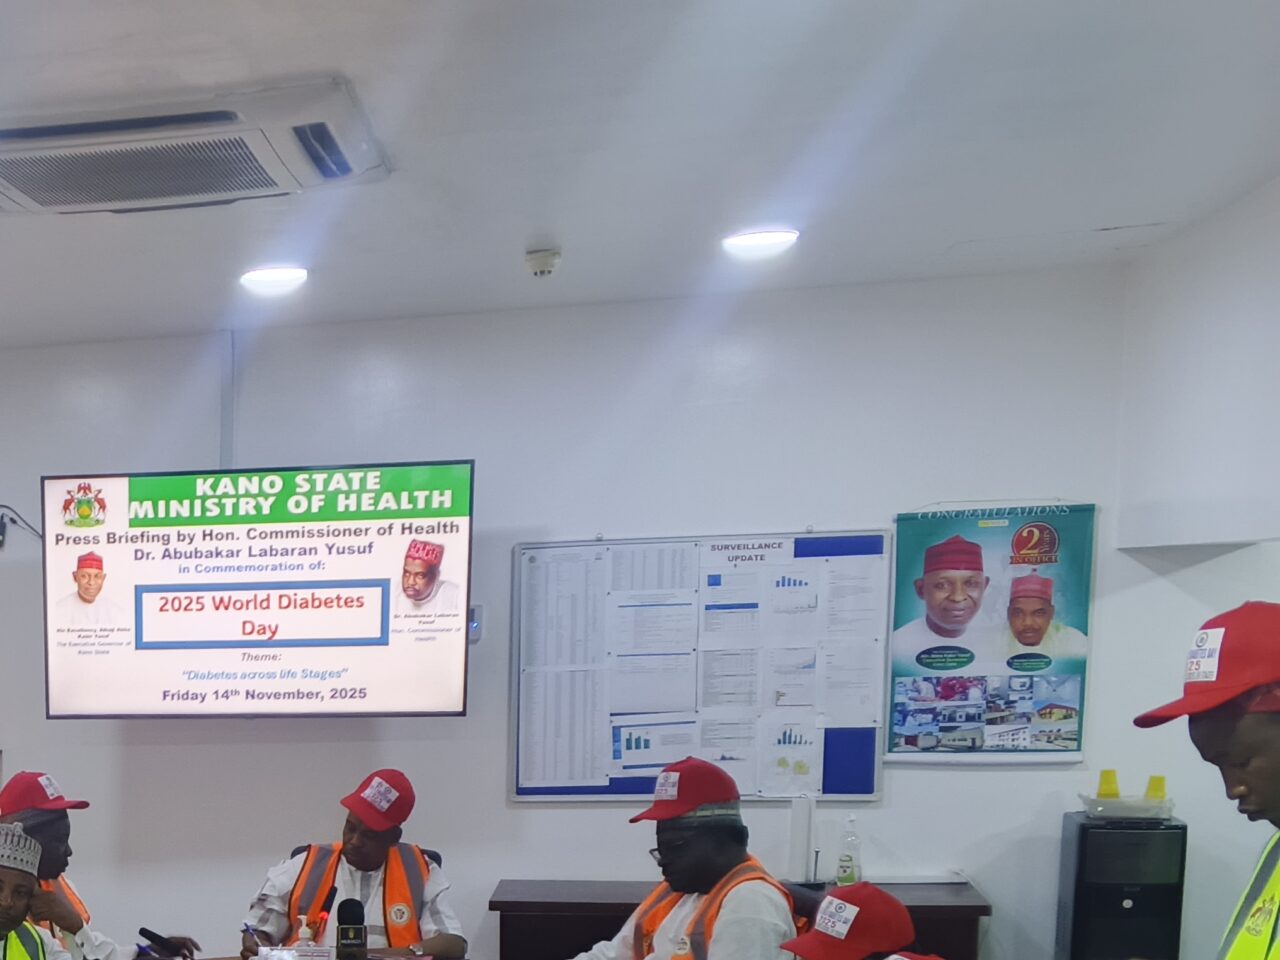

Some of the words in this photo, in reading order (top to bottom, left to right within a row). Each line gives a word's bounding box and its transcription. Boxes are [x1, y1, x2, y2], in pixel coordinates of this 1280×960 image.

[196, 475, 283, 497] KANO
[295, 471, 381, 493] STATE
[129, 496, 276, 519] MINISTRY
[287, 494, 326, 514] OF
[337, 489, 452, 513] HEALTH
[917, 504, 1071, 520] CONGRATULATIONS
[55, 532, 100, 546] Press
[107, 531, 171, 546] Briefing
[177, 530, 196, 544] by
[202, 528, 240, 542] Hon.
[247, 525, 371, 541] Commissioner
[377, 522, 394, 536] of
[400, 520, 460, 536] Health
[1022, 527, 1040, 554] 2
[134, 548, 155, 561] Dr.
[161, 546, 242, 560] Abubakar
[248, 544, 318, 558] Labaran
[325, 541, 374, 556] Yusuf
[710, 541, 784, 552] SURVEILLANCE
[179, 564, 190, 574] in
[194, 561, 304, 574] Commemoration
[309, 559, 326, 571] of:
[727, 553, 766, 562] UPDATE
[159, 596, 205, 613] 2025
[212, 593, 271, 611] World
[278, 592, 365, 610] Diabetes
[242, 620, 279, 641] Day
[241, 652, 282, 662] Theme:
[240, 670, 276, 680] across
[280, 669, 298, 680] life
[162, 689, 207, 703] Friday
[212, 688, 240, 701] 14th
[245, 688, 325, 702] November,
[329, 687, 368, 700] 2025
